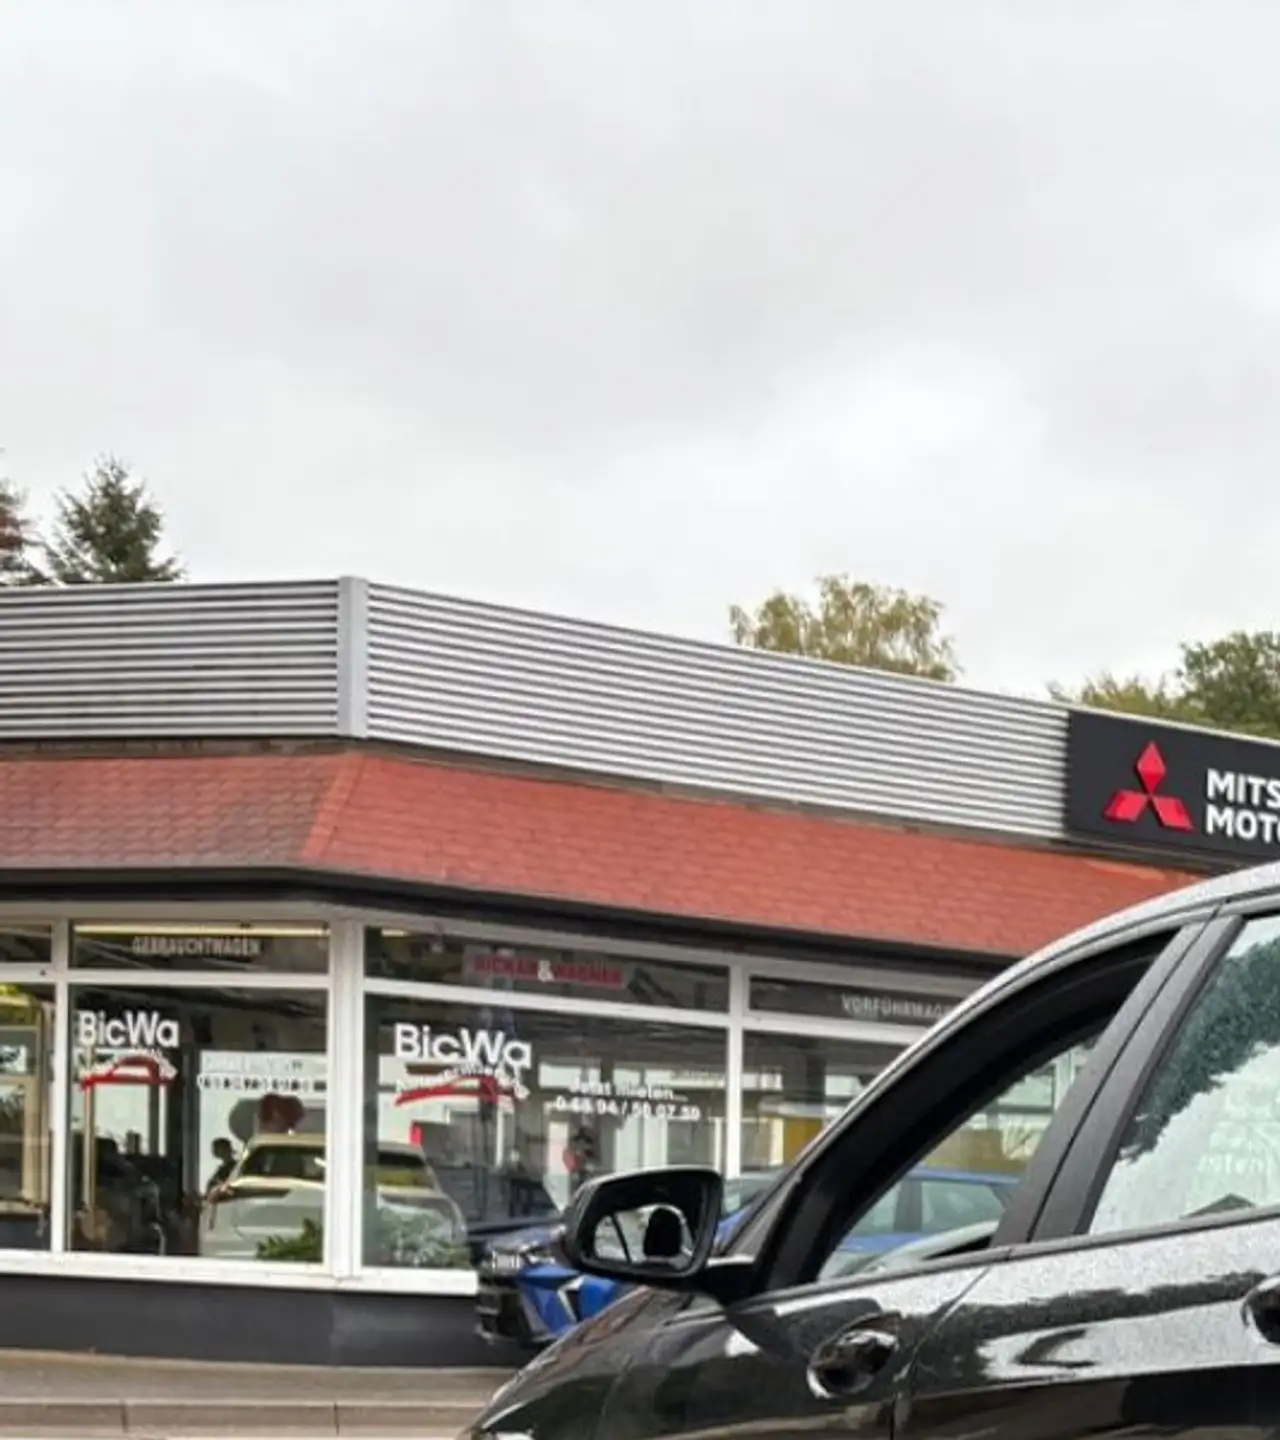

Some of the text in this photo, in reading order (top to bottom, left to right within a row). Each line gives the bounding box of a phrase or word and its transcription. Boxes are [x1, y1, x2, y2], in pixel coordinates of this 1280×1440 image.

[537, 960, 556, 983] &
[79, 1009, 179, 1048] BicWa
[394, 1021, 532, 1069] BicWa
